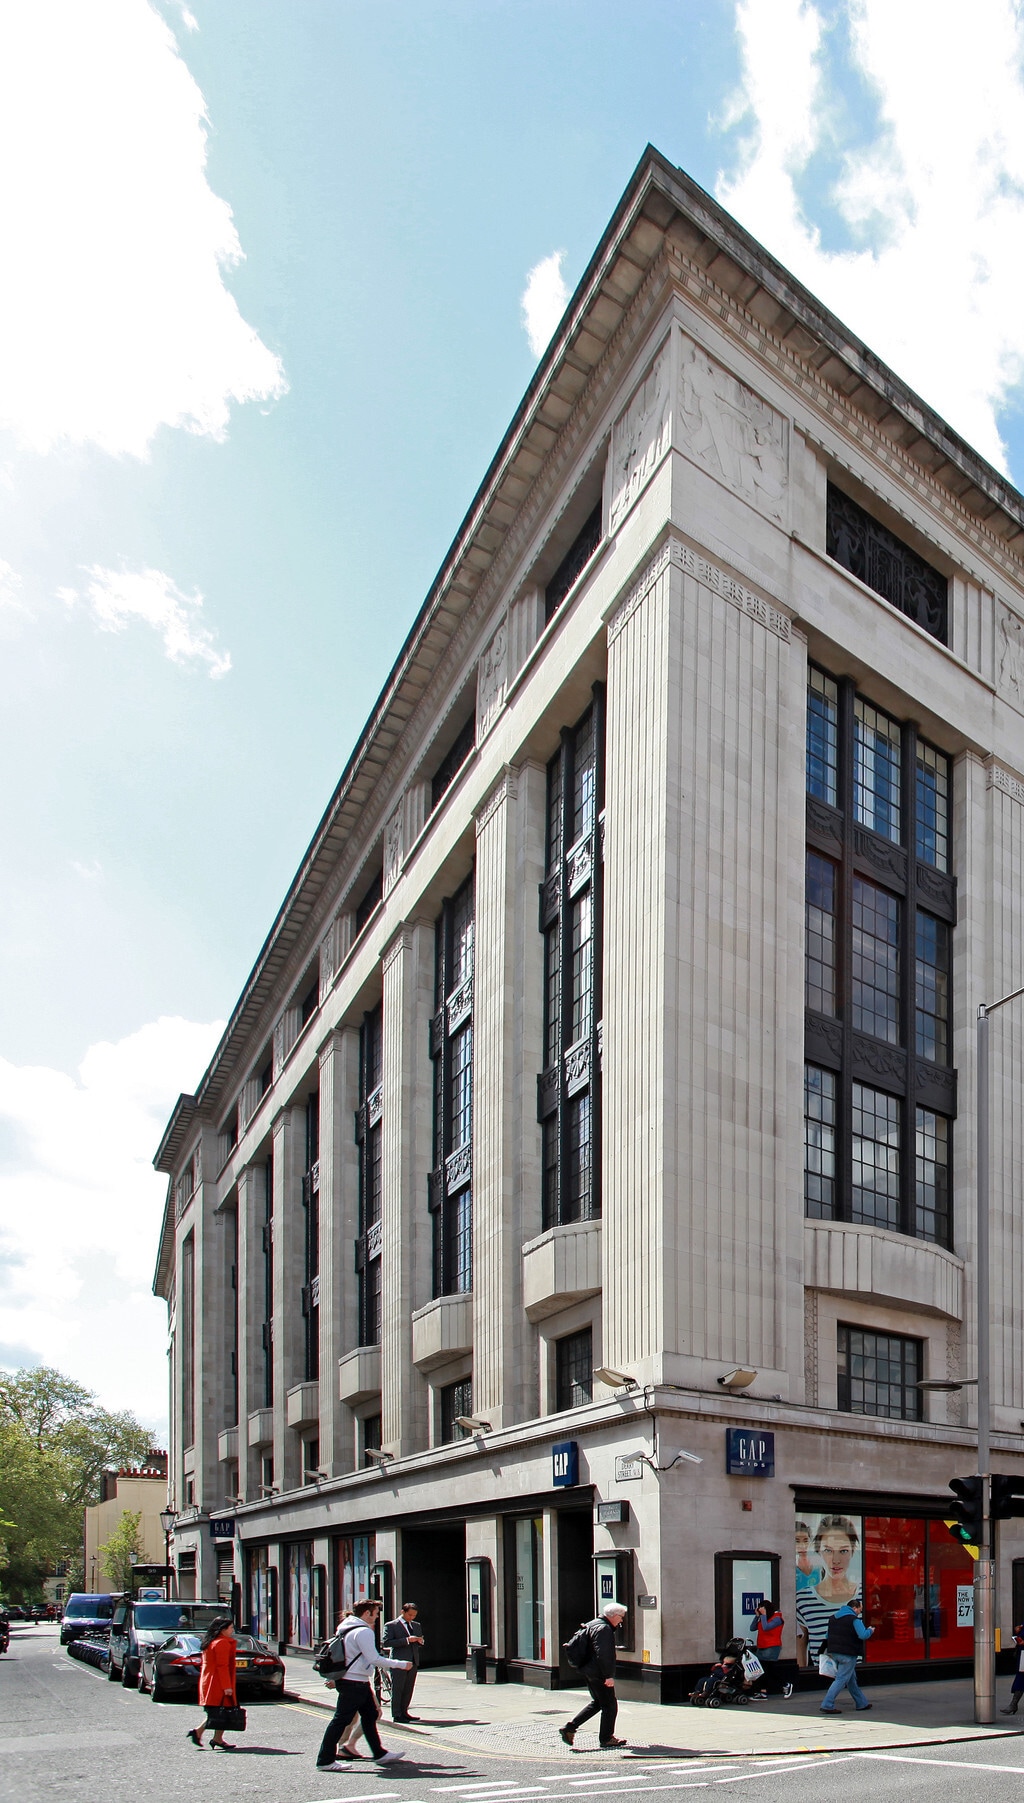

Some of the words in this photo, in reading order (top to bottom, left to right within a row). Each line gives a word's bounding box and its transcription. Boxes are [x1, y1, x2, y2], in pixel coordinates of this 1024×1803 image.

[739, 1438, 766, 1461] GAP
[554, 1452, 569, 1477] GAP
[214, 1521, 231, 1532] GAP
[602, 1580, 612, 1594] GAP
